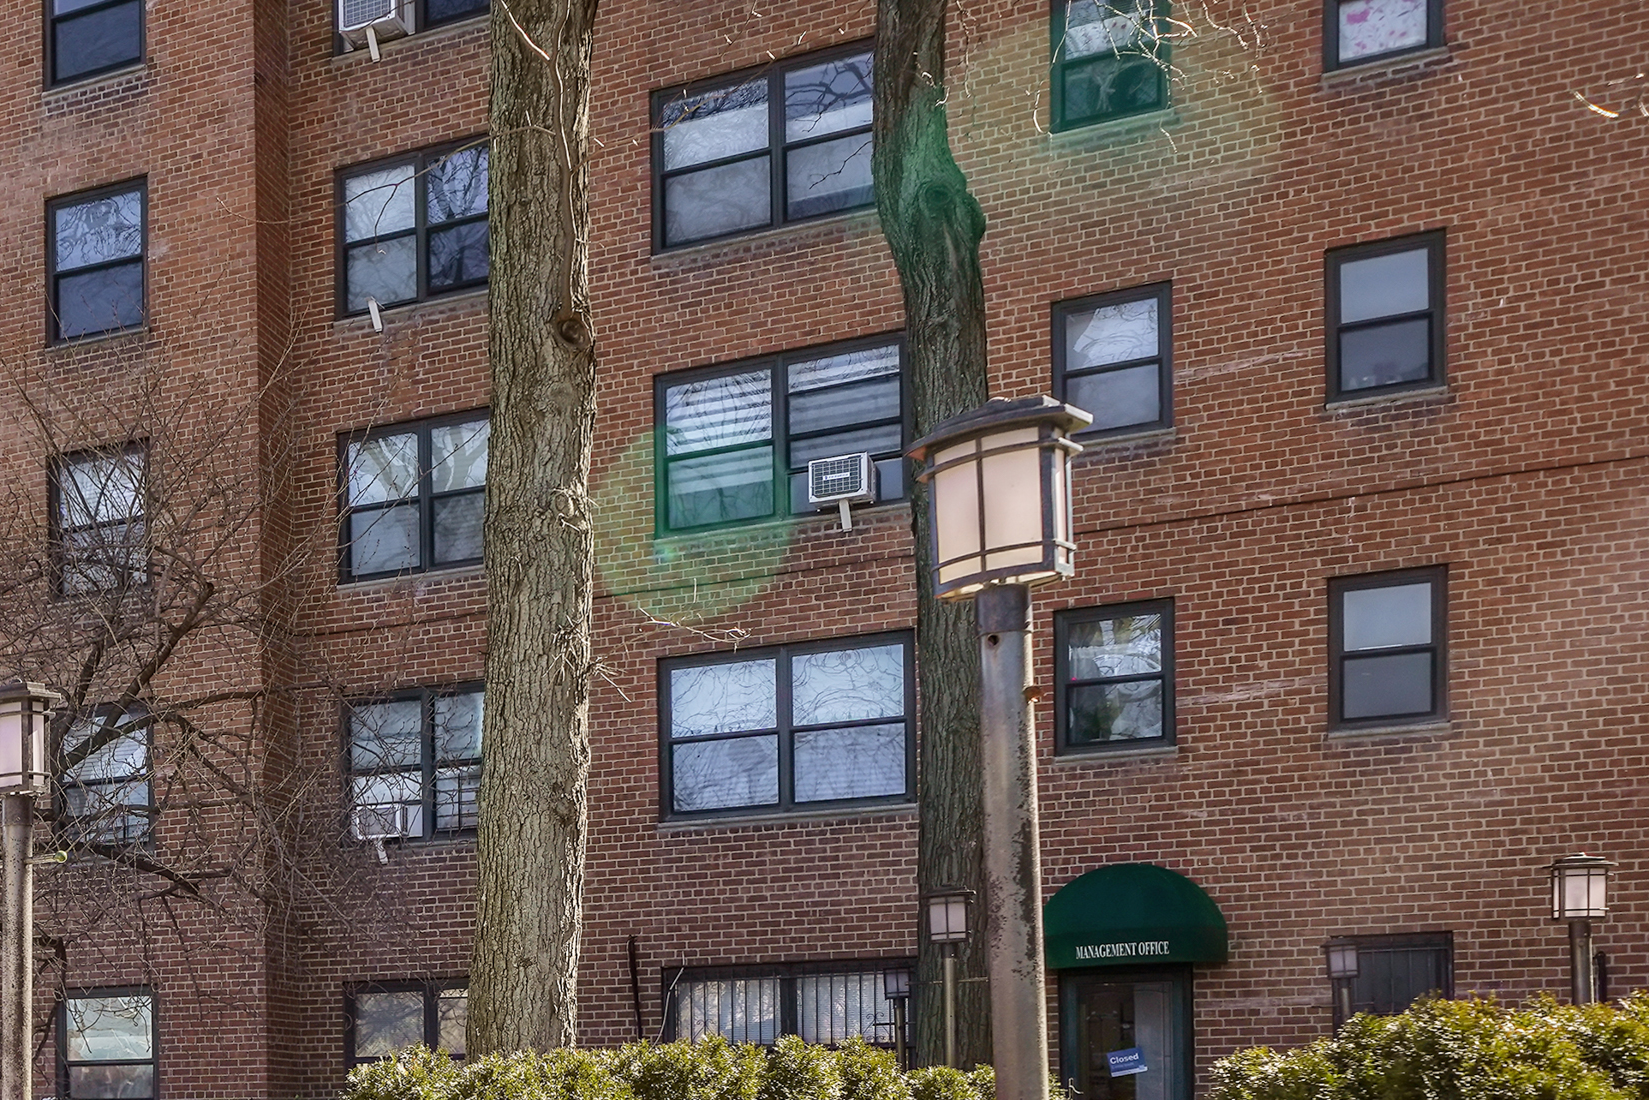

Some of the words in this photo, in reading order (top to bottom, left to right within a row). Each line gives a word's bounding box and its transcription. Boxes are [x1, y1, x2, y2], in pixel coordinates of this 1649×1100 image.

[1075, 942, 1137, 960] MANAGEMENT
[1138, 941, 1170, 956] OFFICE
[1109, 1052, 1140, 1064] Closed
